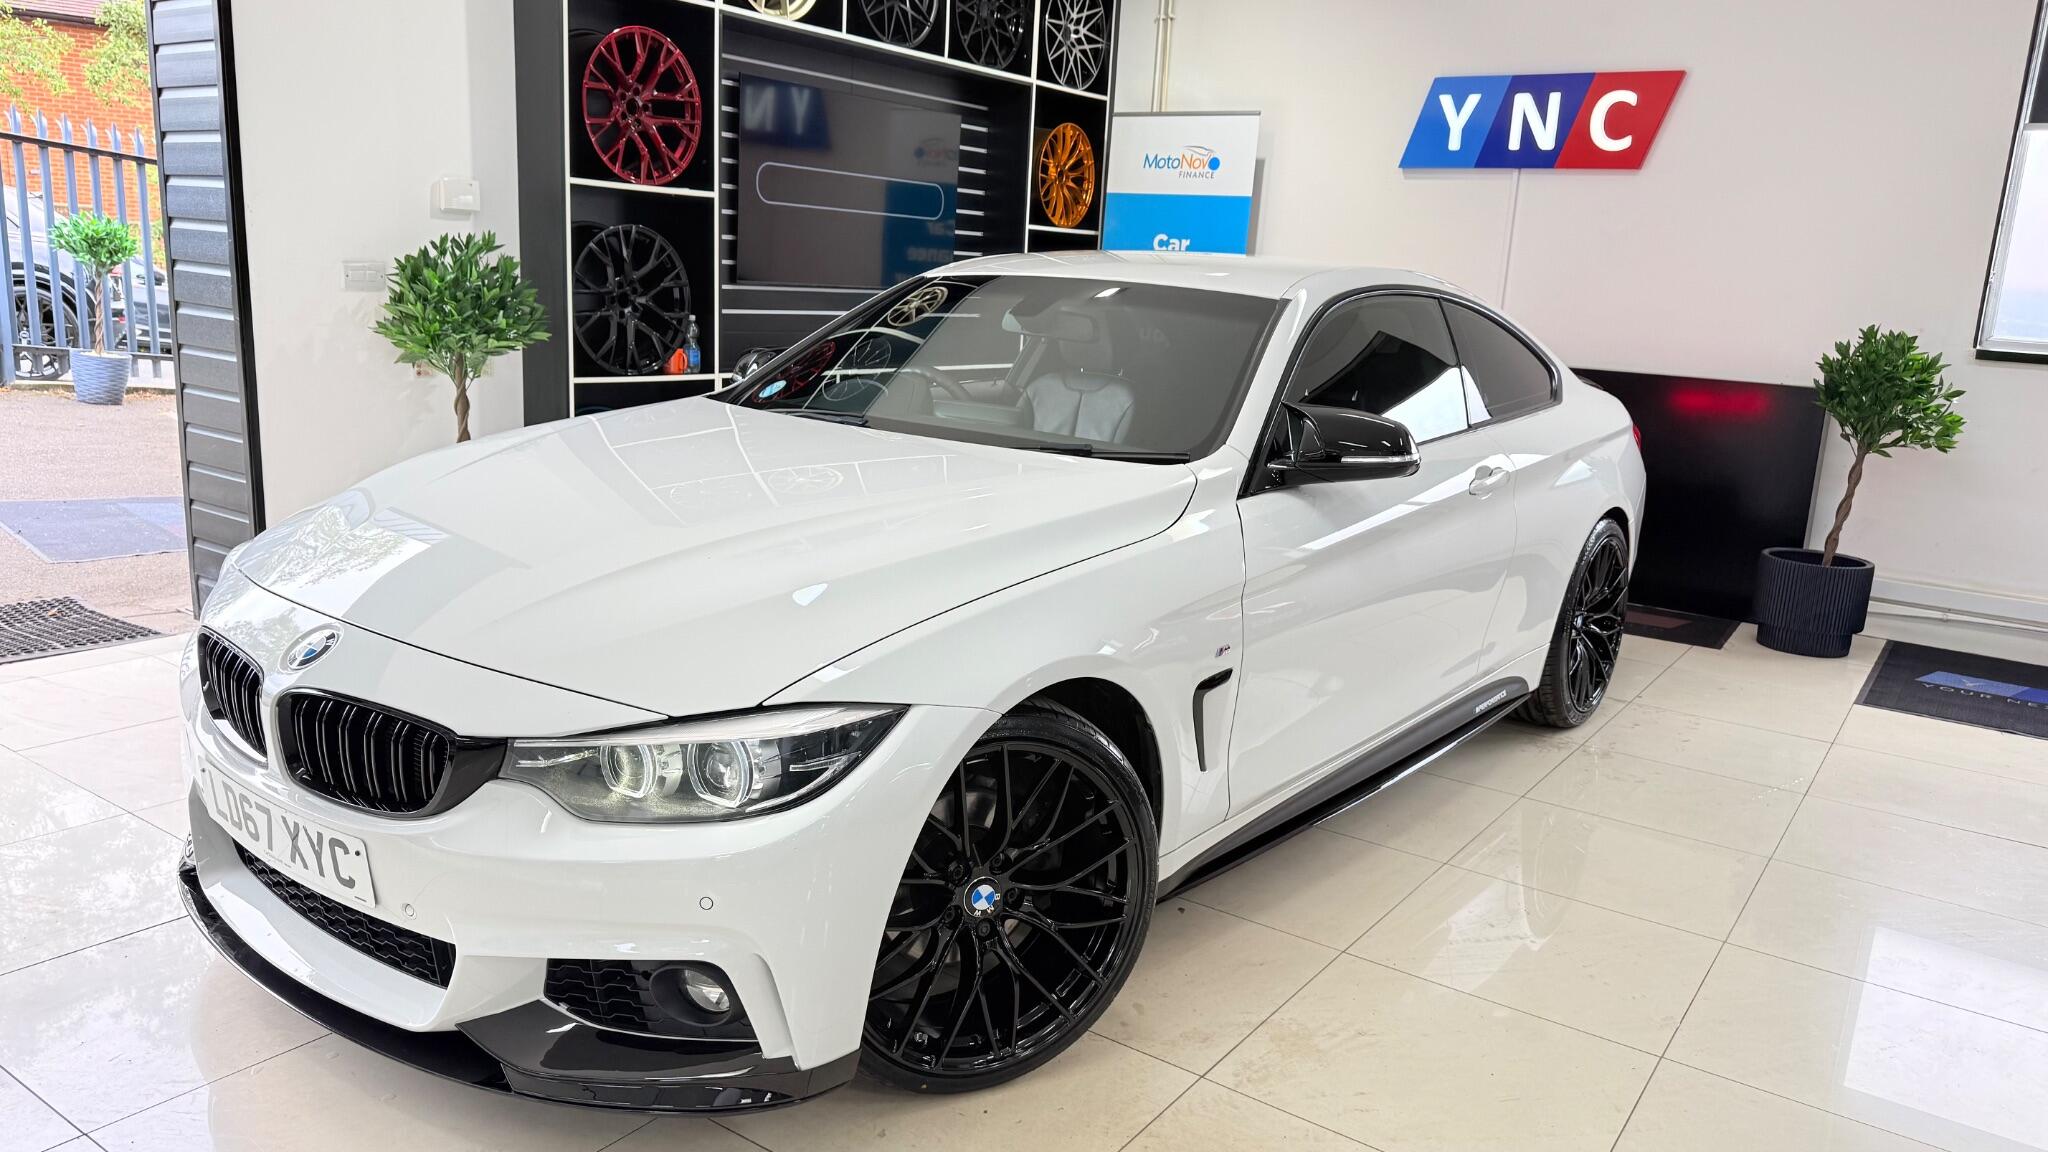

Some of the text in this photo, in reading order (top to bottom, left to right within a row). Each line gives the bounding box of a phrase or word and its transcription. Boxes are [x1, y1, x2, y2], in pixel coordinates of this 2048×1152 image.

[1438, 89, 1638, 152] YNC
[1143, 152, 1221, 171] MotoNovo
[1178, 170, 1215, 179] FINANCE
[1153, 233, 1191, 251] Car
[1921, 683, 1992, 698] YOUR
[208, 769, 355, 889] LD67 XYC
